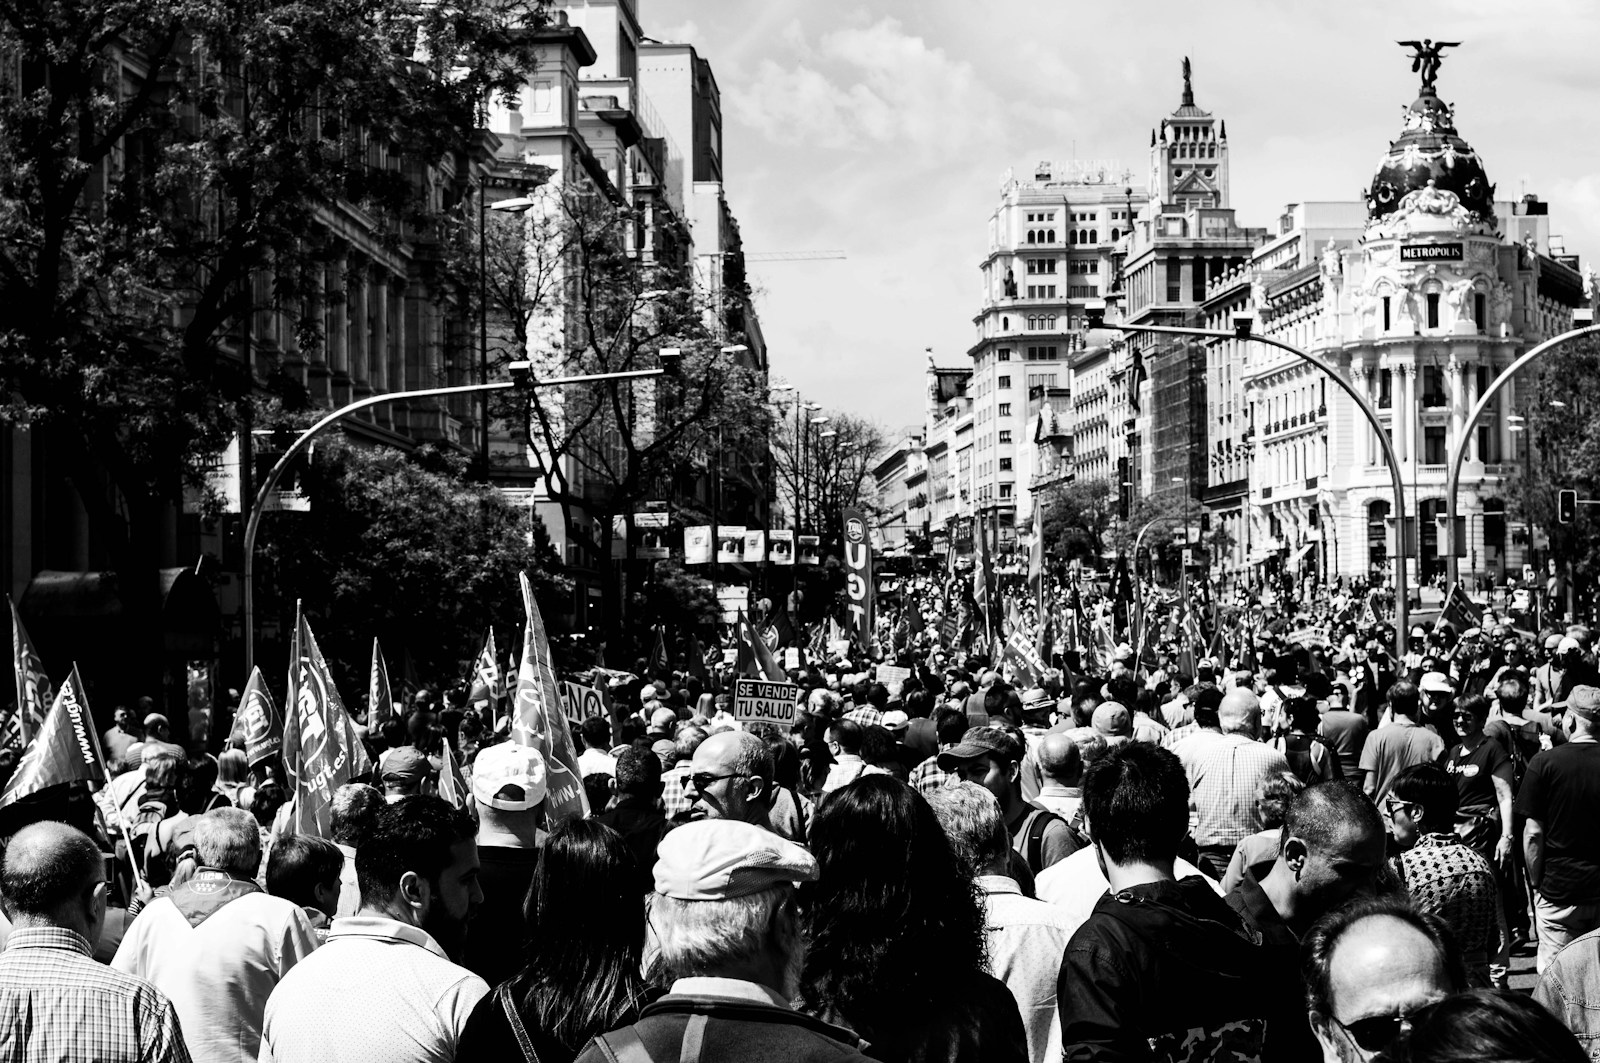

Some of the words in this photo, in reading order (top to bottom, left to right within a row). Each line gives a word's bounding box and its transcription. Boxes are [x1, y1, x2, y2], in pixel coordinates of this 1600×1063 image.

[1402, 247, 1461, 259] METROPOLIS
[1527, 571, 1536, 583] P
[738, 684, 753, 697] SE
[756, 685, 797, 700] VENDE
[738, 700, 753, 717] TU
[755, 701, 794, 720] SALUD
